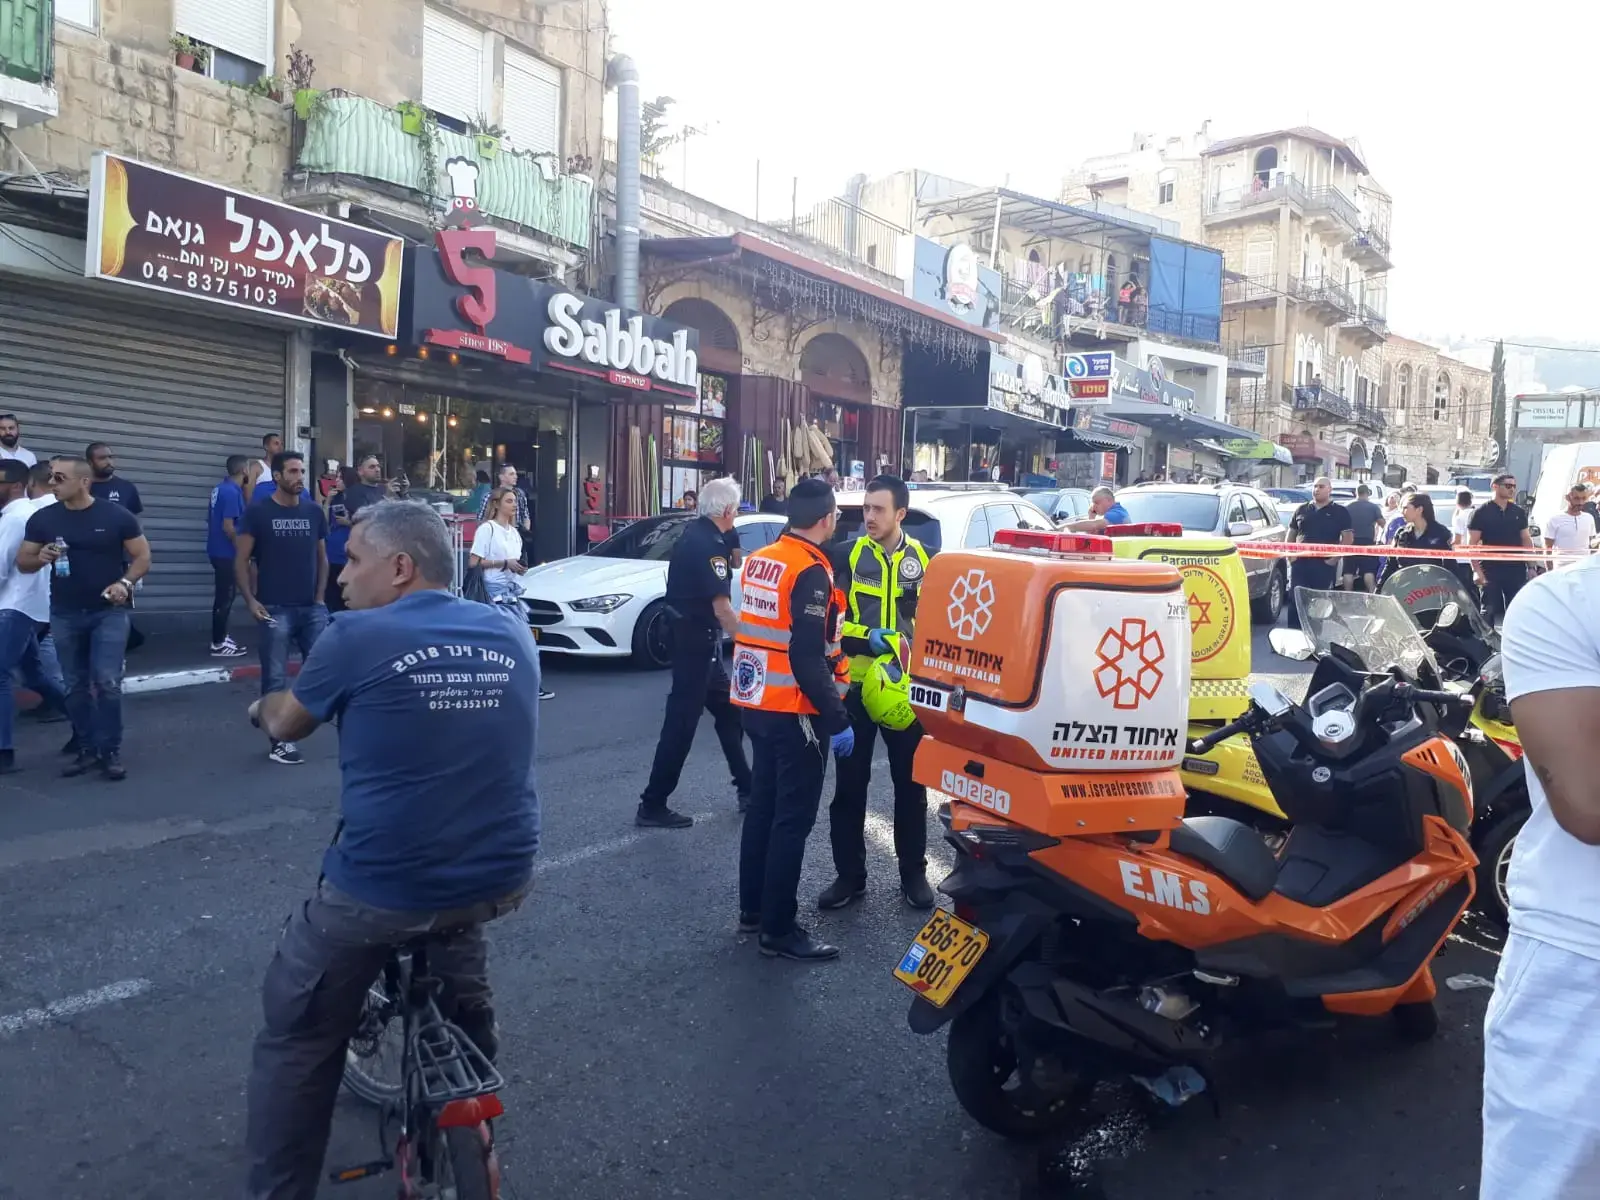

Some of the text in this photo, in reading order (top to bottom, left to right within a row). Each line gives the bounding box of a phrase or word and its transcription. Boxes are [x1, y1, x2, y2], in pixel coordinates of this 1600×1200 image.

[146, 196, 372, 283] פלאפל גנאם
[210, 257, 229, 275] נקי
[235, 263, 257, 278] טרי
[142, 261, 277, 305] 04-8375103
[262, 269, 295, 288] תמיד
[459, 333, 485, 349] since
[544, 293, 698, 386] Sabbah
[615, 373, 646, 387] שוארמה
[747, 559, 784, 584] חובש
[1161, 555, 1220, 566] Paramedic
[391, 646, 440, 673] 2018
[477, 647, 516, 670] מוסך
[924, 638, 1004, 672] איחוד הצלה
[408, 673, 509, 684] פחחות וצבע בתנור
[923, 656, 1001, 685] UNITED HATZALAH
[429, 699, 500, 710] 052-6352192
[911, 686, 942, 708] 1010
[1052, 720, 1178, 746] איחוד הצלה
[1050, 746, 1175, 761] UNITED HATZALAH
[957, 779, 1006, 809] 1221
[1060, 779, 1177, 799] www.israelrescue.org
[1118, 859, 1210, 915] E.M.S
[917, 952, 954, 991] 801
